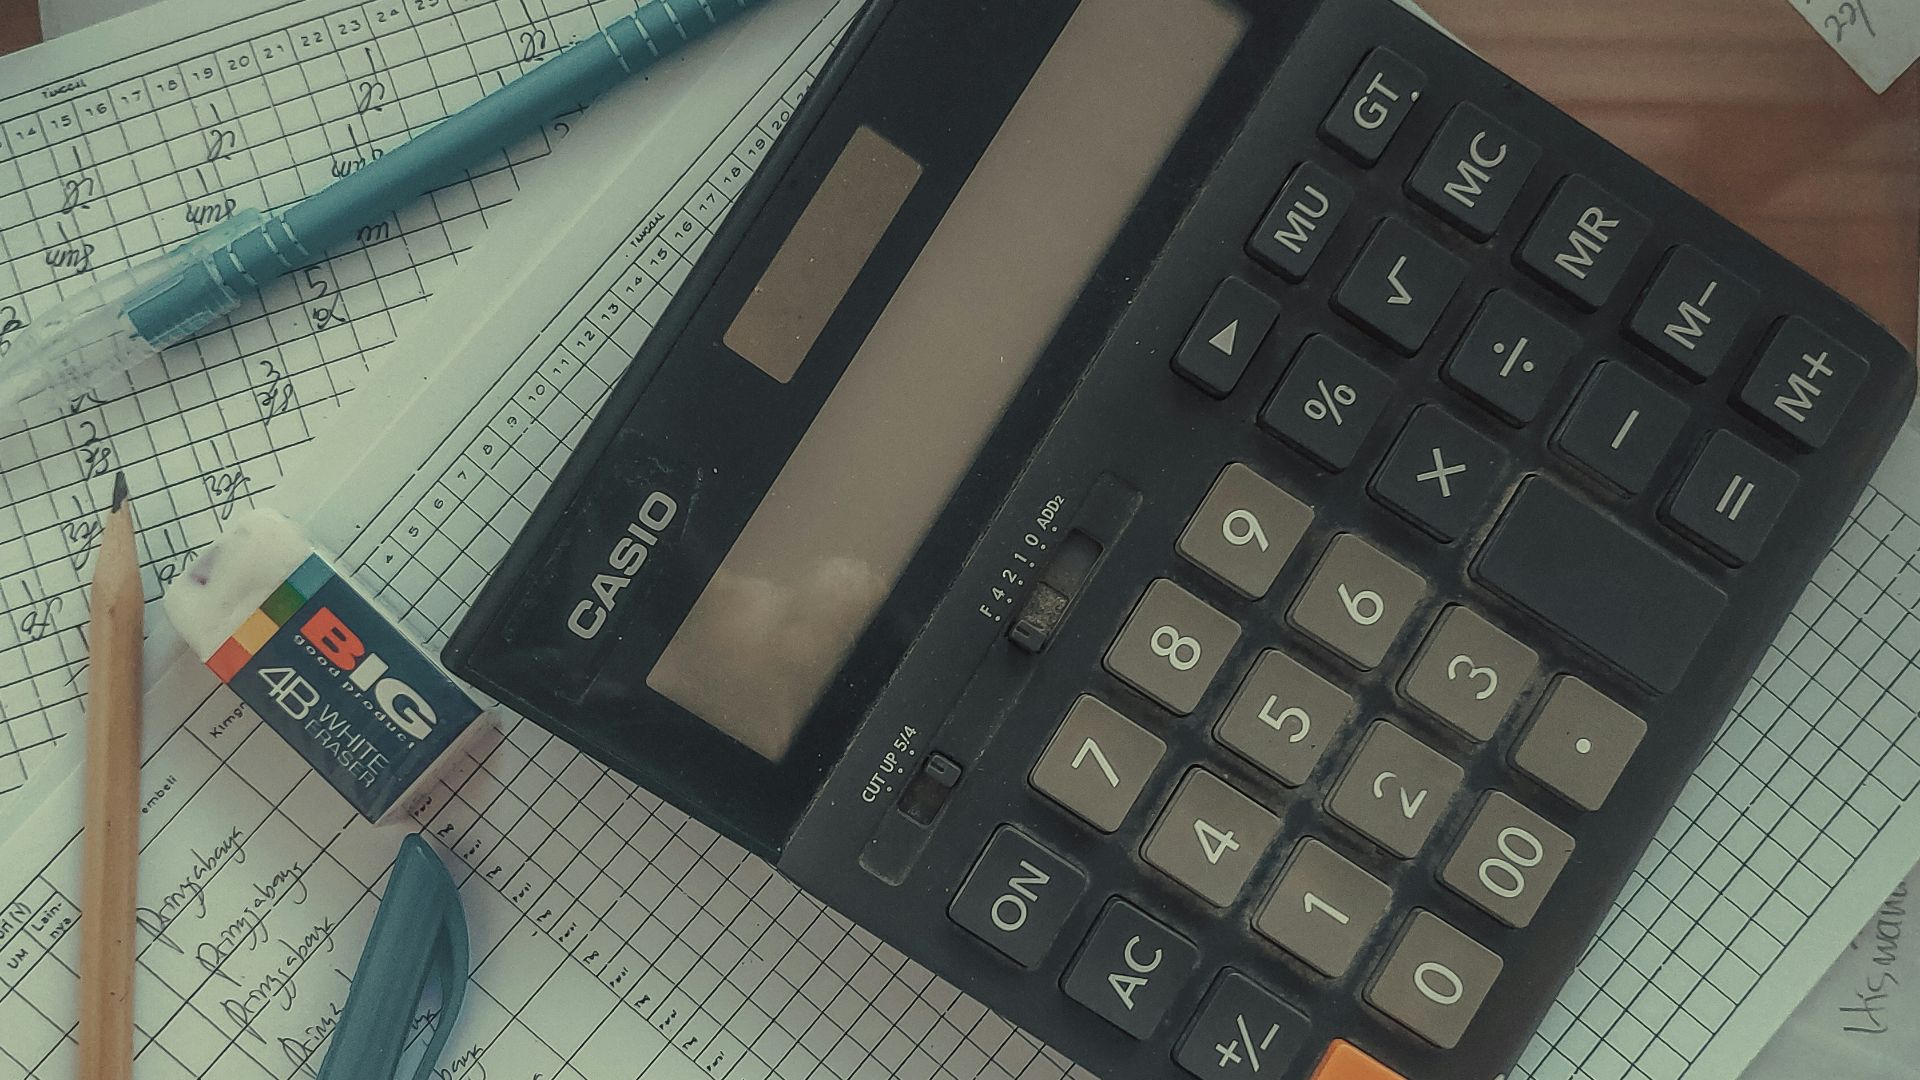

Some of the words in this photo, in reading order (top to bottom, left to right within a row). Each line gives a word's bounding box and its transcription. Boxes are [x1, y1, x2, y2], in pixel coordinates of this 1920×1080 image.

[51, 115, 72, 129] 15
[85, 103, 107, 117] 16
[121, 90, 142, 104] 17
[156, 79, 178, 93] 18
[192, 66, 214, 81] 19
[228, 55, 250, 71] 20
[263, 45, 285, 60] 21
[301, 30, 324, 47] 22
[337, 19, 362, 36] 23
[1353, 72, 1400, 130] GT
[1443, 131, 1507, 208] MC
[1273, 185, 1329, 254] MU
[1554, 206, 1621, 280] MR
[408, 525, 420, 538] 5
[434, 498, 444, 510] 6
[457, 470, 469, 482] 7
[482, 444, 493, 456] 8
[506, 416, 518, 428] 9
[528, 384, 546, 402] 10
[553, 358, 570, 374] 11
[576, 330, 596, 349] 12
[602, 303, 619, 322] 13
[626, 275, 643, 294] 14
[650, 248, 669, 266] 15
[674, 220, 693, 240] 16
[699, 192, 716, 212] 17
[723, 165, 742, 184] 18
[748, 137, 766, 157] 19
[771, 110, 791, 132] 20
[1304, 379, 1357, 426] %
[1774, 351, 1834, 422] M+
[567, 491, 678, 639] CASIO
[1222, 508, 1270, 553] 9
[979, 604, 993, 618] F
[991, 586, 1006, 601] 4
[1002, 569, 1018, 584] 2
[1014, 552, 1028, 564] 1
[1024, 533, 1039, 547] 0
[1337, 583, 1384, 625] 6
[293, 634, 341, 678] good
[300, 607, 437, 741] BIG
[1150, 625, 1201, 671] 8
[1447, 654, 1498, 700] 3
[257, 667, 321, 720] 4B
[1257, 694, 1311, 743] 5
[304, 719, 376, 789] ERASER
[319, 704, 389, 776] WHITE
[861, 772, 886, 803] CUT
[879, 752, 898, 773] UP
[893, 725, 917, 752] 5/4
[1071, 737, 1120, 788] 7
[1372, 771, 1428, 819] 2
[1192, 819, 1240, 865] 4
[1478, 826, 1544, 898] 00
[990, 860, 1050, 931] ON
[1303, 891, 1350, 925] 1
[1107, 935, 1162, 1011] AC
[1413, 961, 1464, 1005] 0
